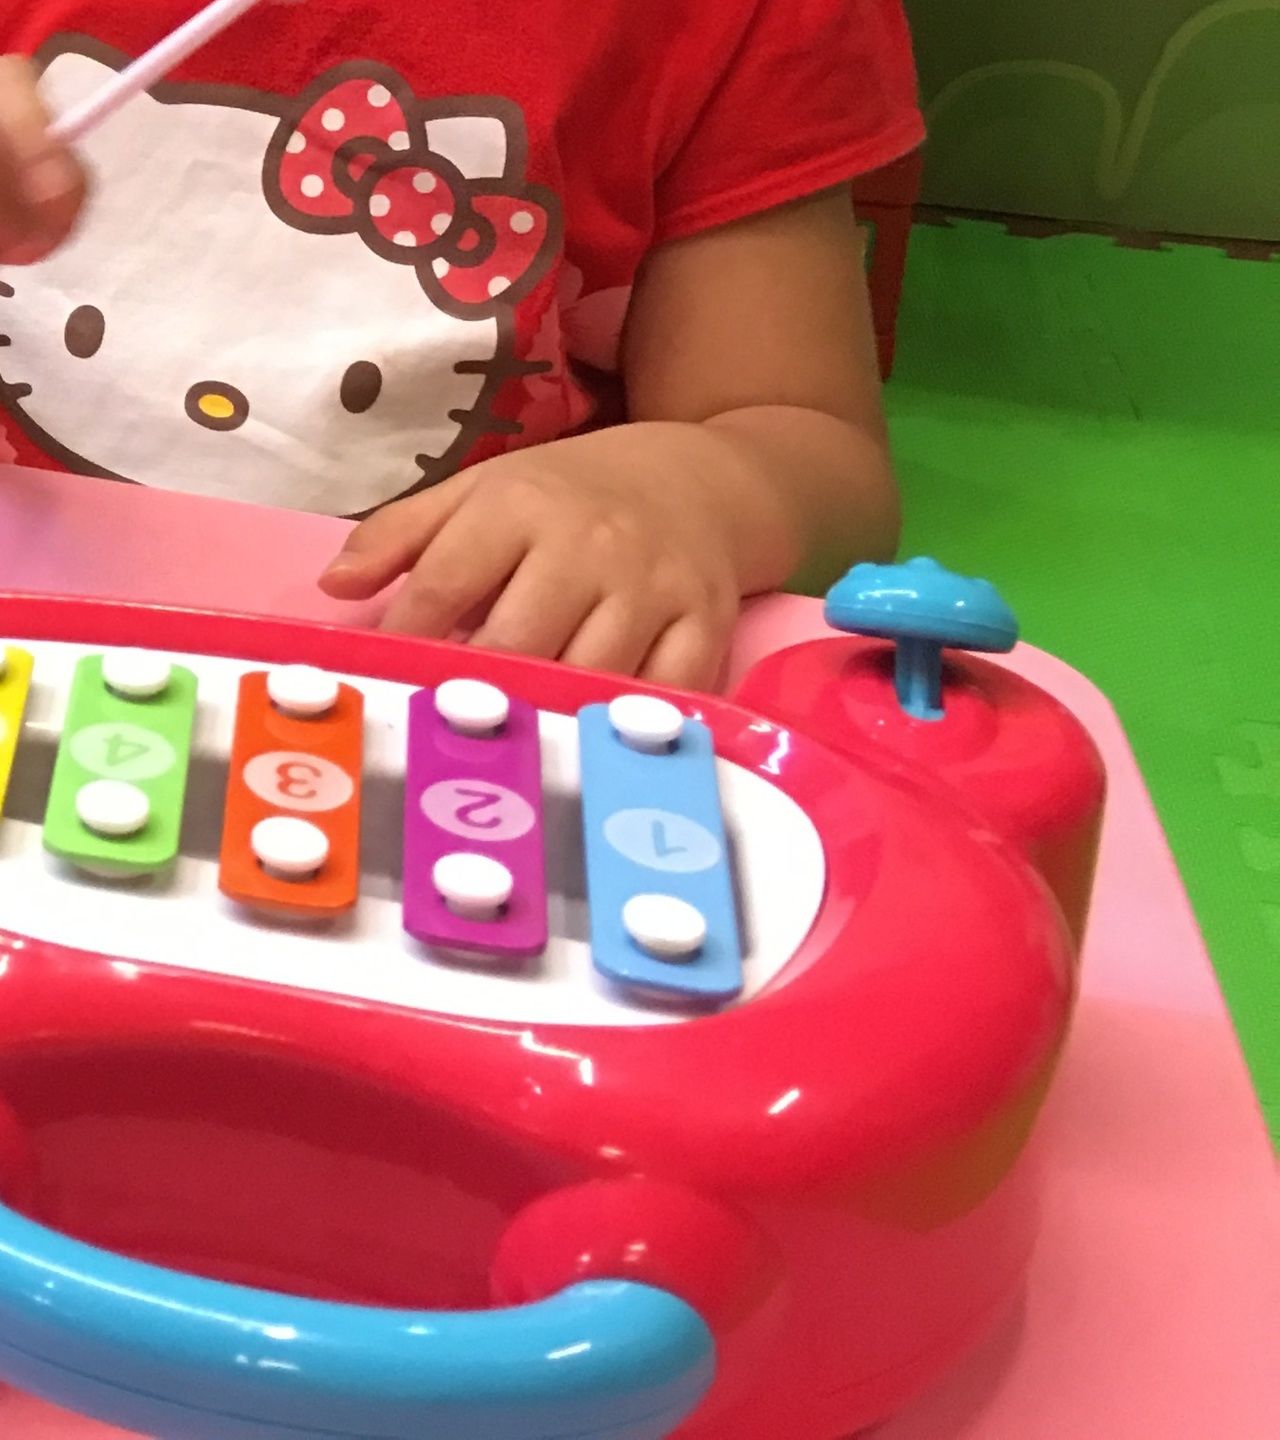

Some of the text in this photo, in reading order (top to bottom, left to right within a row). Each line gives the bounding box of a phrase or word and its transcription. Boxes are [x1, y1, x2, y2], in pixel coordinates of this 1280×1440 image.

[102, 733, 152, 768] 4
[275, 761, 322, 800] 3
[454, 786, 503, 829] 2
